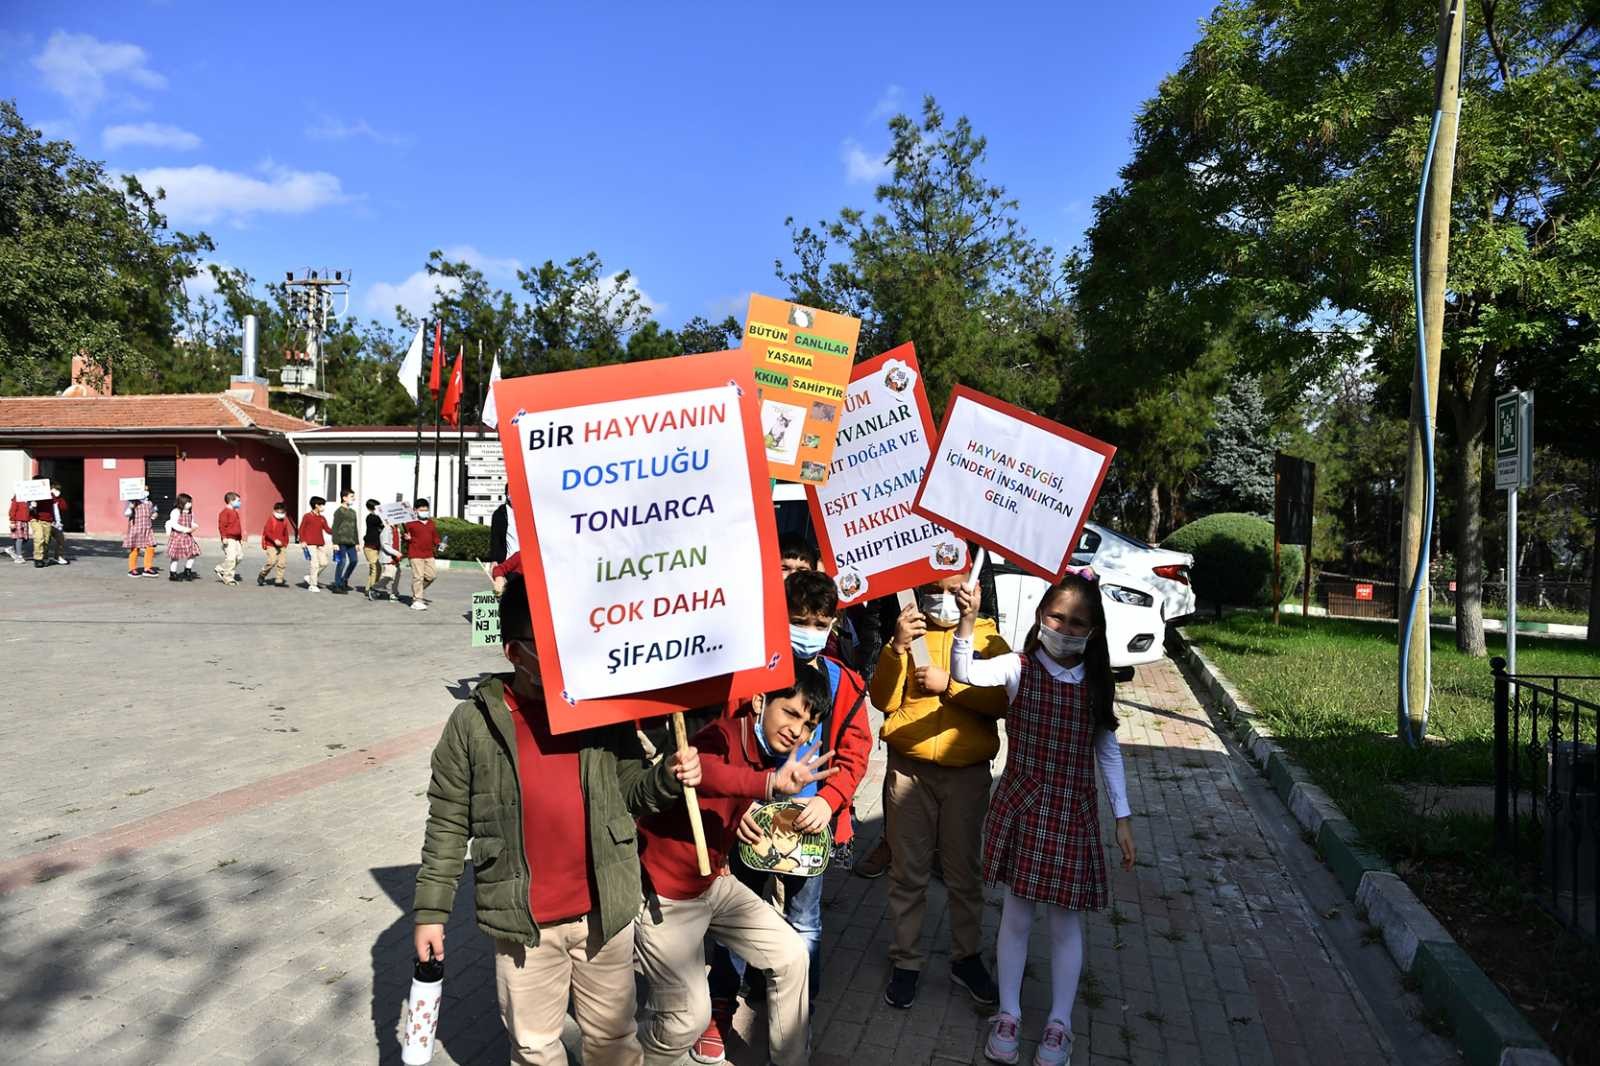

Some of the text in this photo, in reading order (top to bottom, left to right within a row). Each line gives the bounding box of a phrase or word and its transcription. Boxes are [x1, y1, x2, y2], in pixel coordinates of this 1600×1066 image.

[749, 325, 849, 355] BÜTÜN CANLILAR
[767, 349, 813, 367] YAŞAMA
[754, 371, 843, 398] KKINA SAHİPTİR
[843, 390, 872, 414] ÜM
[529, 403, 726, 451] BİR HAYVANIN
[835, 404, 912, 447] YVANLAR
[847, 438, 898, 468] DOĞAR
[899, 429, 919, 447] VE
[967, 439, 1064, 493] HAYVAN SEVGİSİ,
[562, 446, 709, 491] DOSTLUĞU
[946, 449, 1073, 518] İÇİNDEKİ İNSANLIKTAN
[824, 466, 926, 516] EŞİT YAŞAMA
[984, 489, 1019, 514] GELİR.
[570, 494, 715, 534] TONLARCA
[843, 501, 912, 538] HAKKIN
[596, 545, 707, 583] İLAÇTAN
[589, 587, 726, 633] ÇOK DAHA
[485, 633, 503, 643] LAR
[607, 634, 724, 675] ŞİFADIR...
[800, 855, 823, 867] 10
[801, 844, 824, 856] BEN
